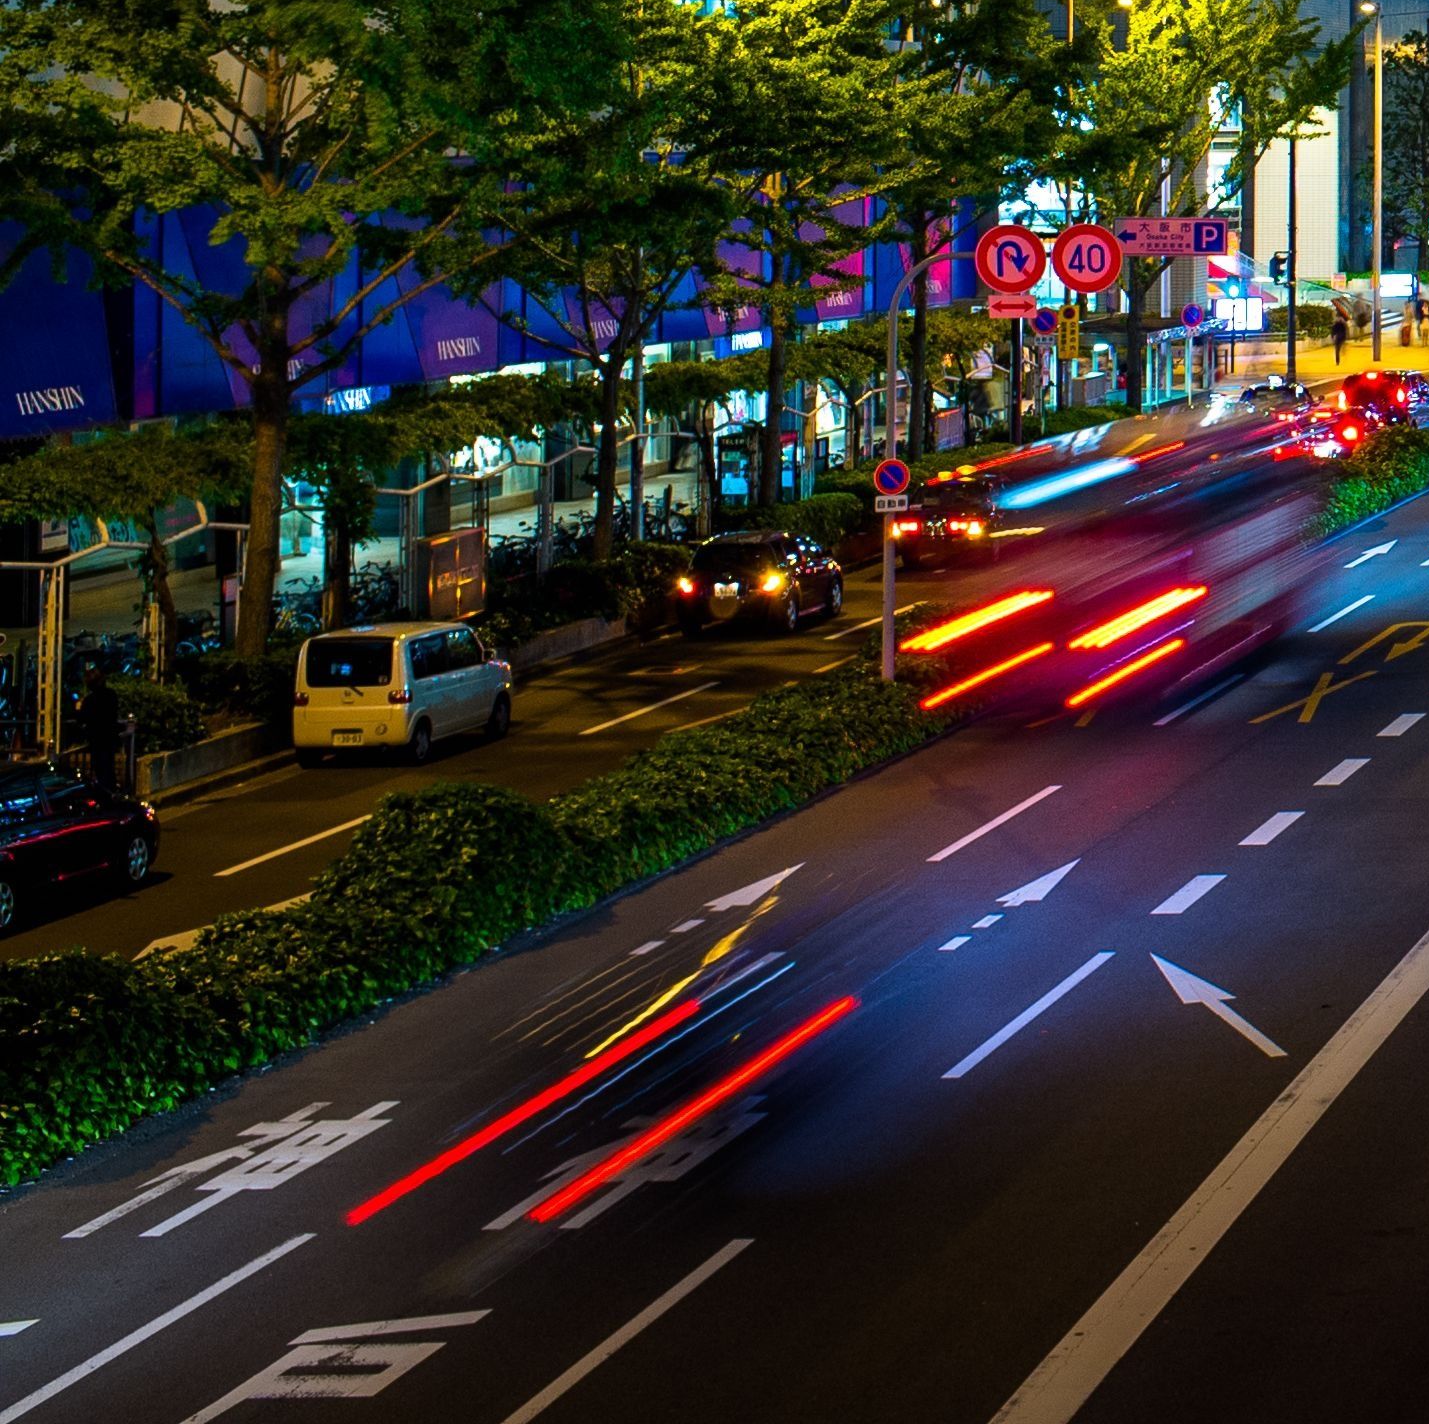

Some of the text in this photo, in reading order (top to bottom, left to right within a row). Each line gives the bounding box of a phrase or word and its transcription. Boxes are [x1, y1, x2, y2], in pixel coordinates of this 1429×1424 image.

[1138, 222, 1193, 233] 大阪市
[1201, 226, 1218, 249] P
[1067, 243, 1106, 274] 40
[437, 336, 481, 360] HANSHIN
[15, 385, 86, 416] HANSHIN
[877, 498, 906, 509] 自動車
